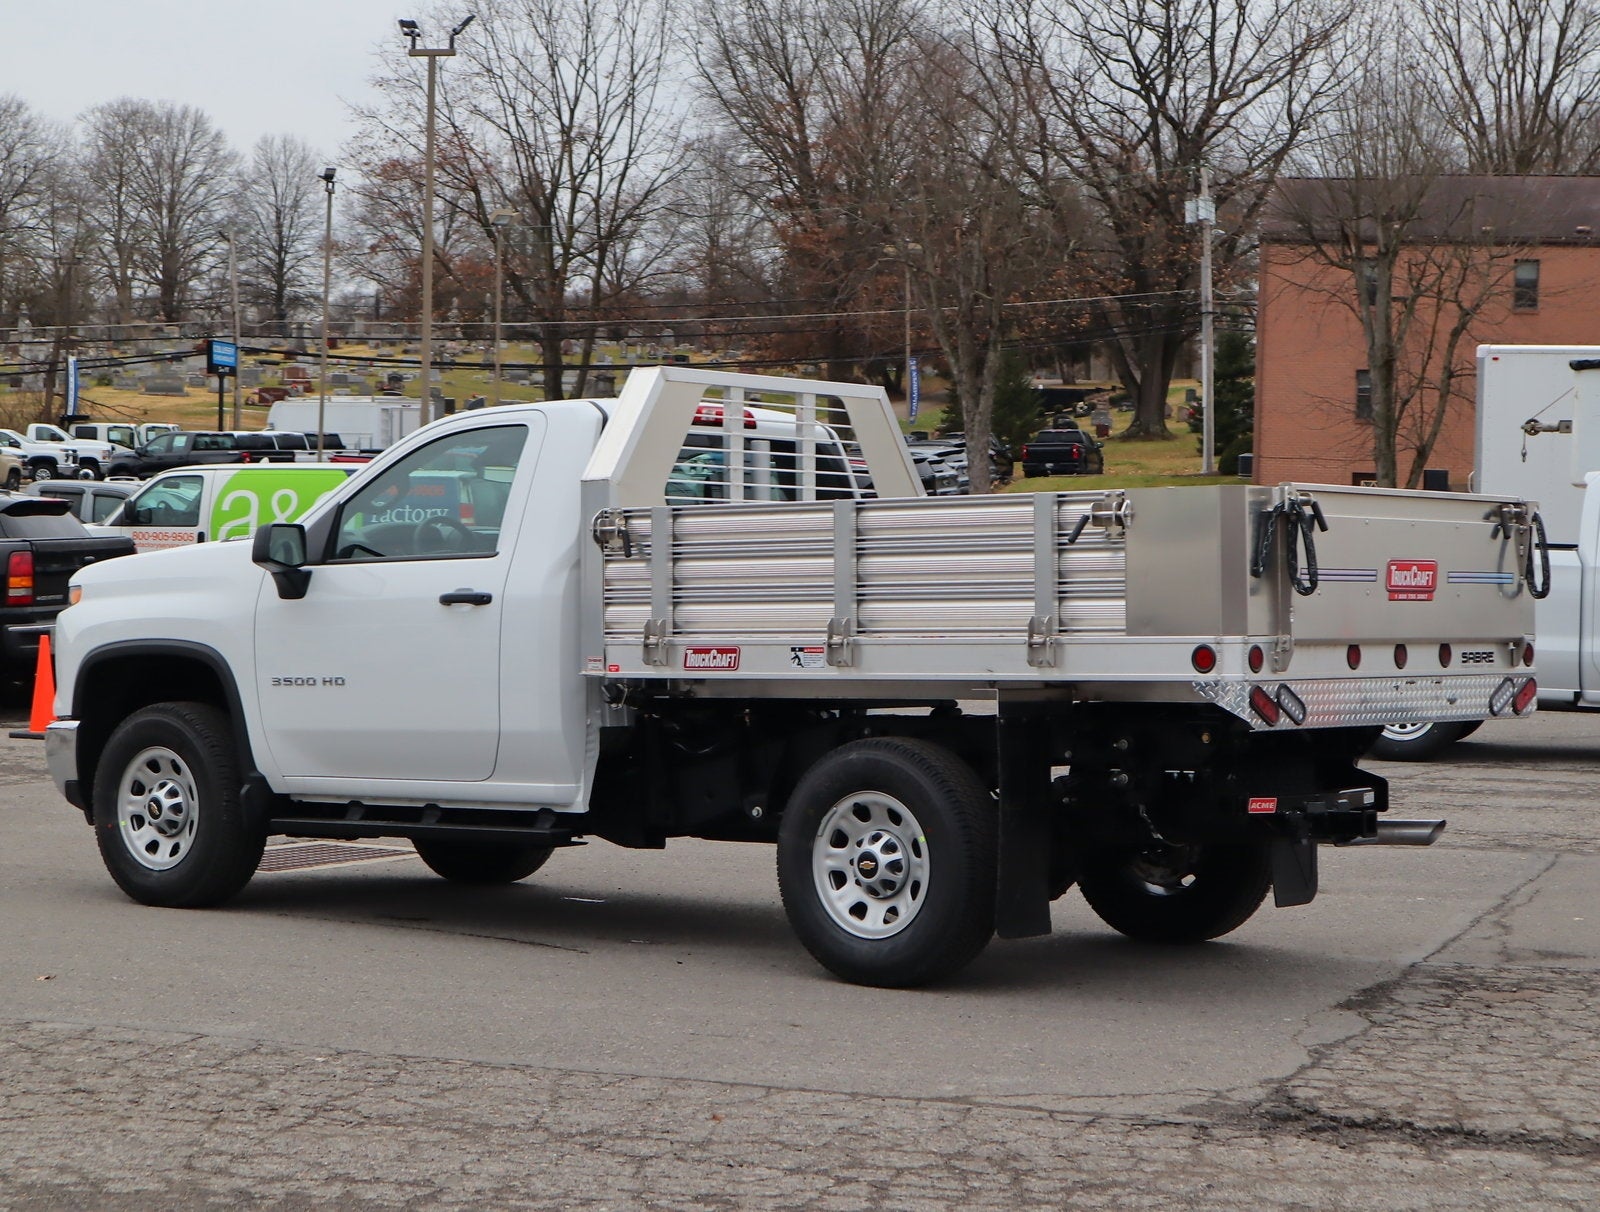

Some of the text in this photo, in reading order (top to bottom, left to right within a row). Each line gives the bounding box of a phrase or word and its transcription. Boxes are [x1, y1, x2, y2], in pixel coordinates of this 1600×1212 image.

[218, 488, 333, 541] a&
[132, 531, 195, 542] 800-905-9505
[1461, 651, 1495, 664] SABRE
[271, 677, 346, 686] 3500 HD
[1250, 801, 1276, 809] ACME
